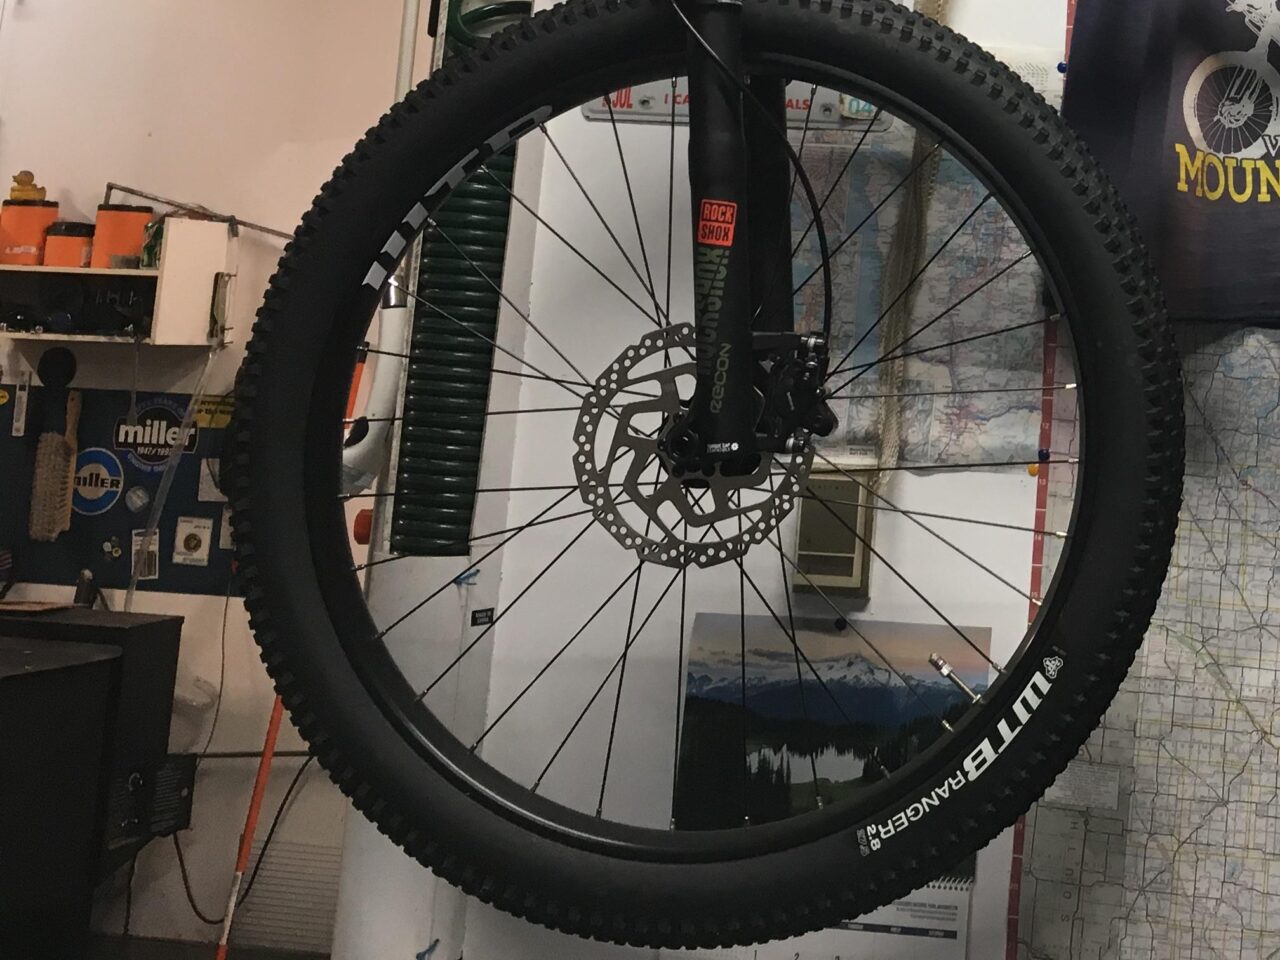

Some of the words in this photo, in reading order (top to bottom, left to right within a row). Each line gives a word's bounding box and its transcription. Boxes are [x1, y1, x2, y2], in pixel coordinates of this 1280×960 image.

[703, 201, 733, 221] ROCK
[701, 224, 731, 242] SHOX
[118, 419, 196, 447] miller
[877, 769, 967, 841] RANGER
[866, 822, 881, 852] 2.8
